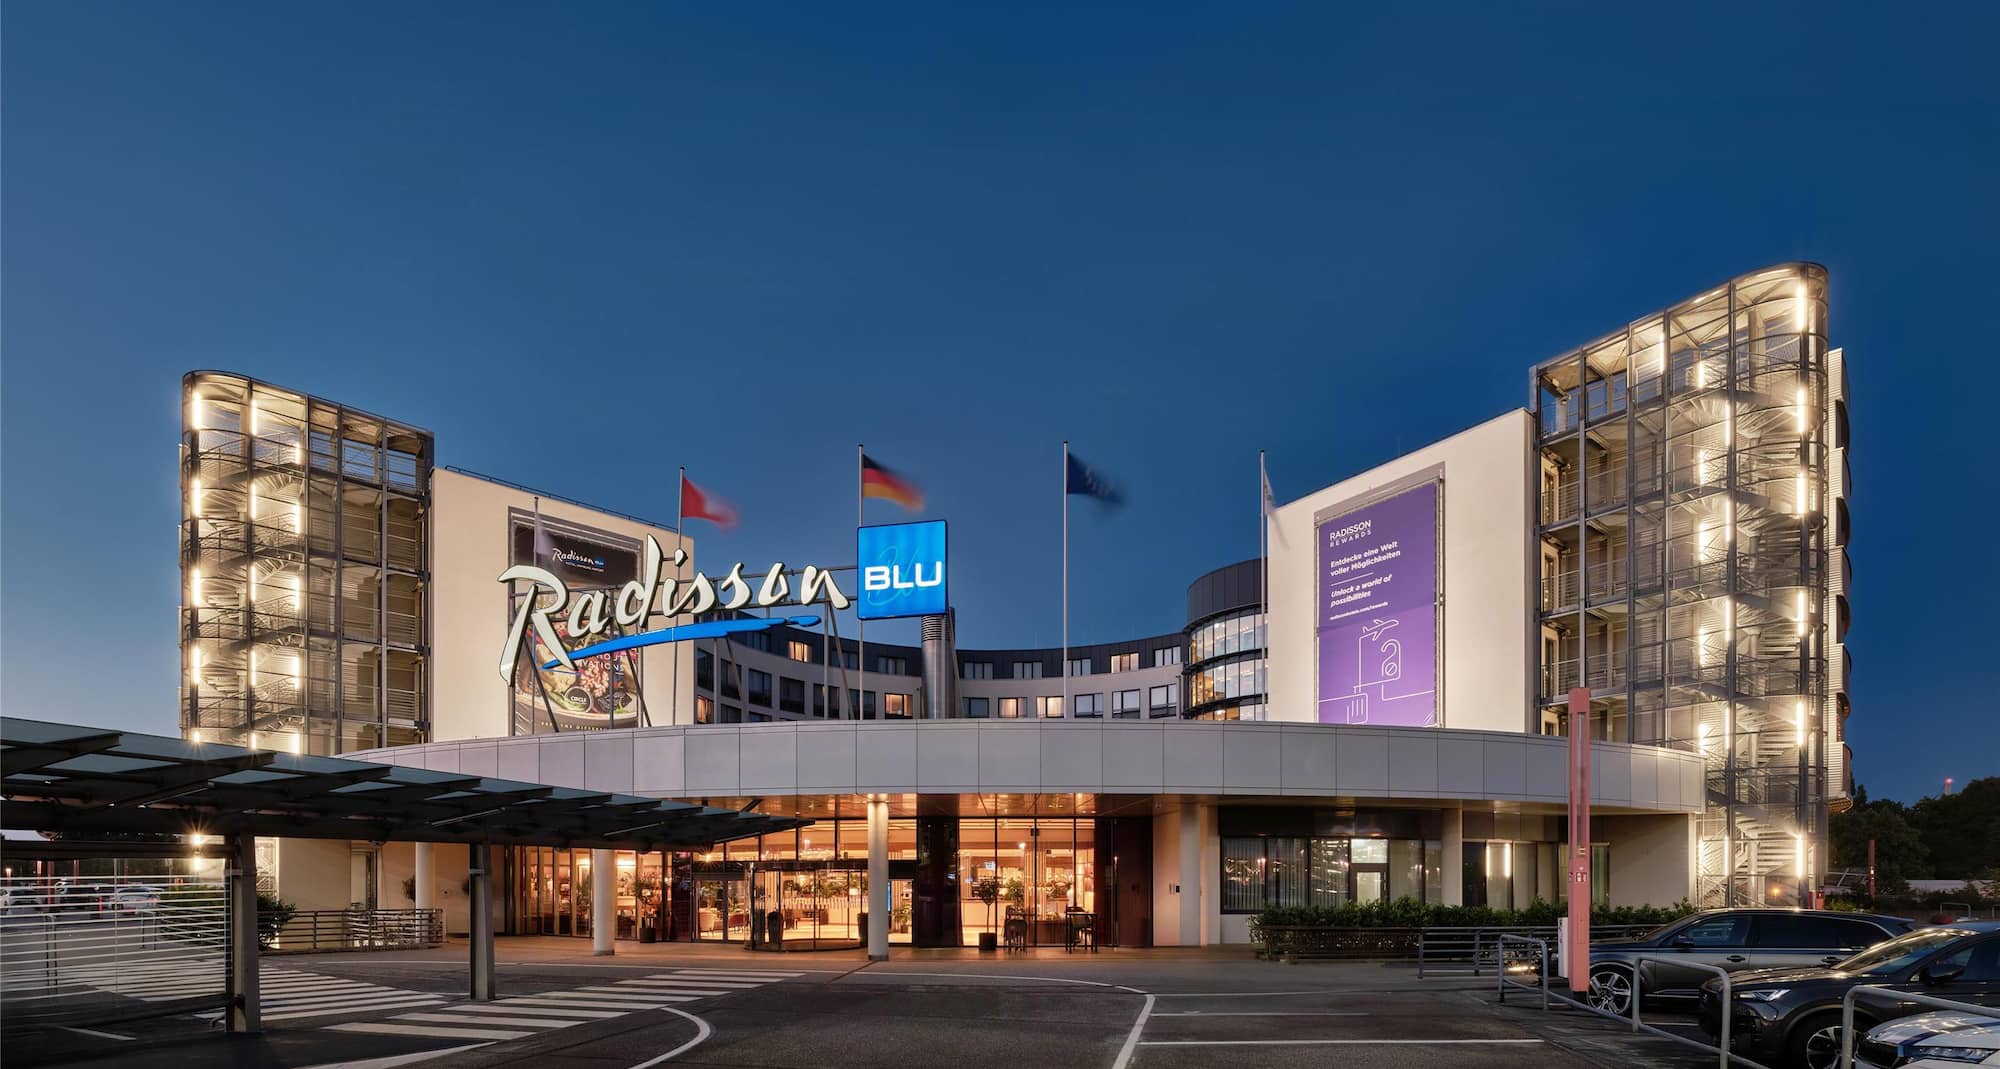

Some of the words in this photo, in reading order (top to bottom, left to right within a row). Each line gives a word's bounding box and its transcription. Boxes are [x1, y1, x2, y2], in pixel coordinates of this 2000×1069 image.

[1329, 519, 1372, 541] RADISSON
[1329, 530, 1372, 548] REWARDS
[1330, 553, 1362, 569] Entdecke
[1380, 540, 1398, 552] Welt
[1330, 566, 1350, 577] voller
[497, 533, 851, 687] Radisson
[864, 560, 943, 591] BLU
